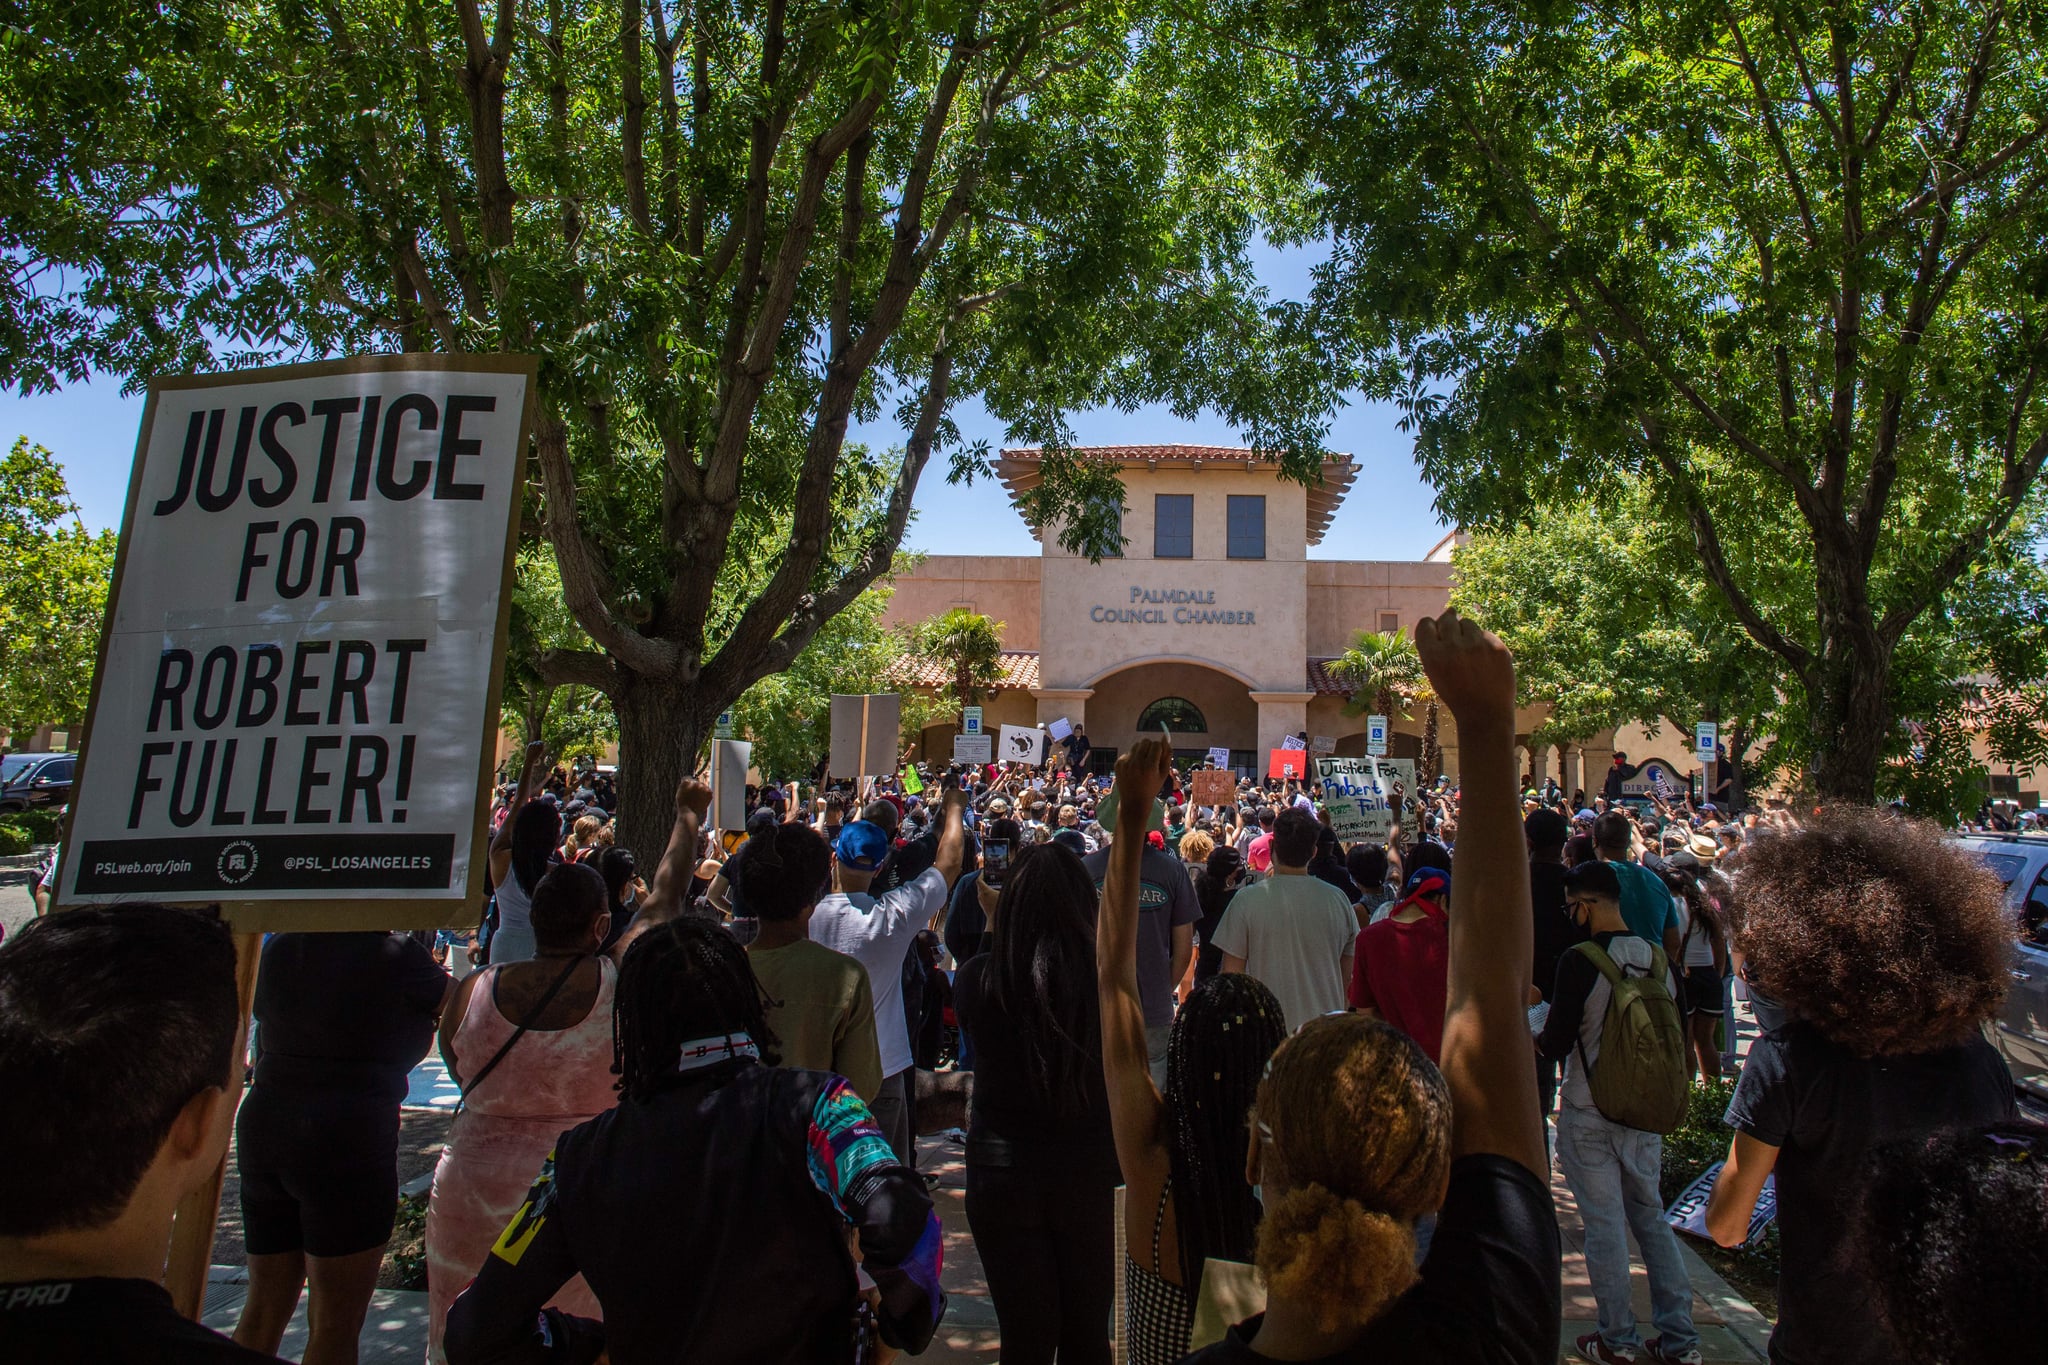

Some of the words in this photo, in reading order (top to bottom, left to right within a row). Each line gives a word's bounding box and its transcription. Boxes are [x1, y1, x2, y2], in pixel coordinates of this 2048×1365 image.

[153, 394, 497, 517] JUSTICE
[235, 516, 367, 602] FOR
[1129, 585, 1216, 604] PALMDALE
[1089, 604, 1168, 624] COUNCIL
[1172, 606, 1256, 625] CHAMBER
[146, 639, 428, 732] ROBERT
[1286, 736, 1304, 749] JUSTICE
[127, 735, 416, 829] FULLER!
[1322, 776, 1382, 799] Robert
[95, 859, 192, 875] PSLweb.org/join
[228, 857, 247, 870] PSL
[284, 856, 432, 872] @PSL_LOSANGELES
[5, 1282, 72, 1311] PRO
